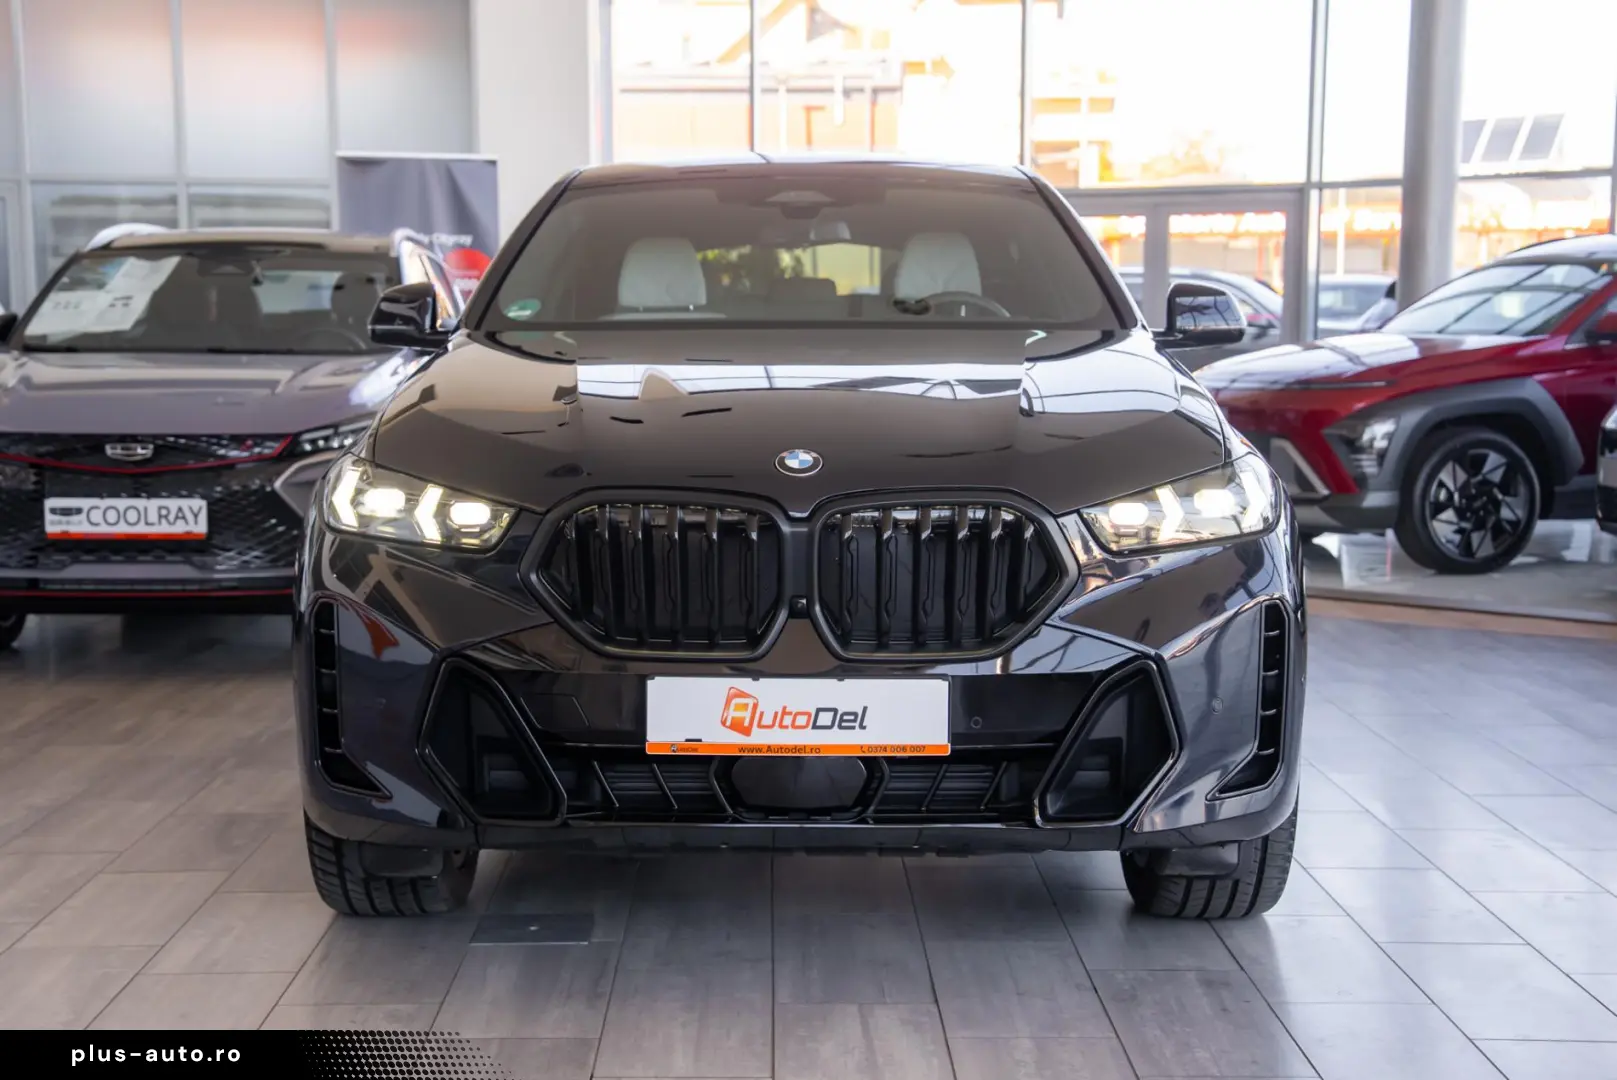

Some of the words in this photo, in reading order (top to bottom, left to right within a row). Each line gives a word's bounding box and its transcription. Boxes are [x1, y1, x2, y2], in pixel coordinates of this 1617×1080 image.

[86, 505, 203, 527] COOLRAY
[722, 690, 869, 735] AutoDel
[737, 745, 822, 754] www.Autodel.ro
